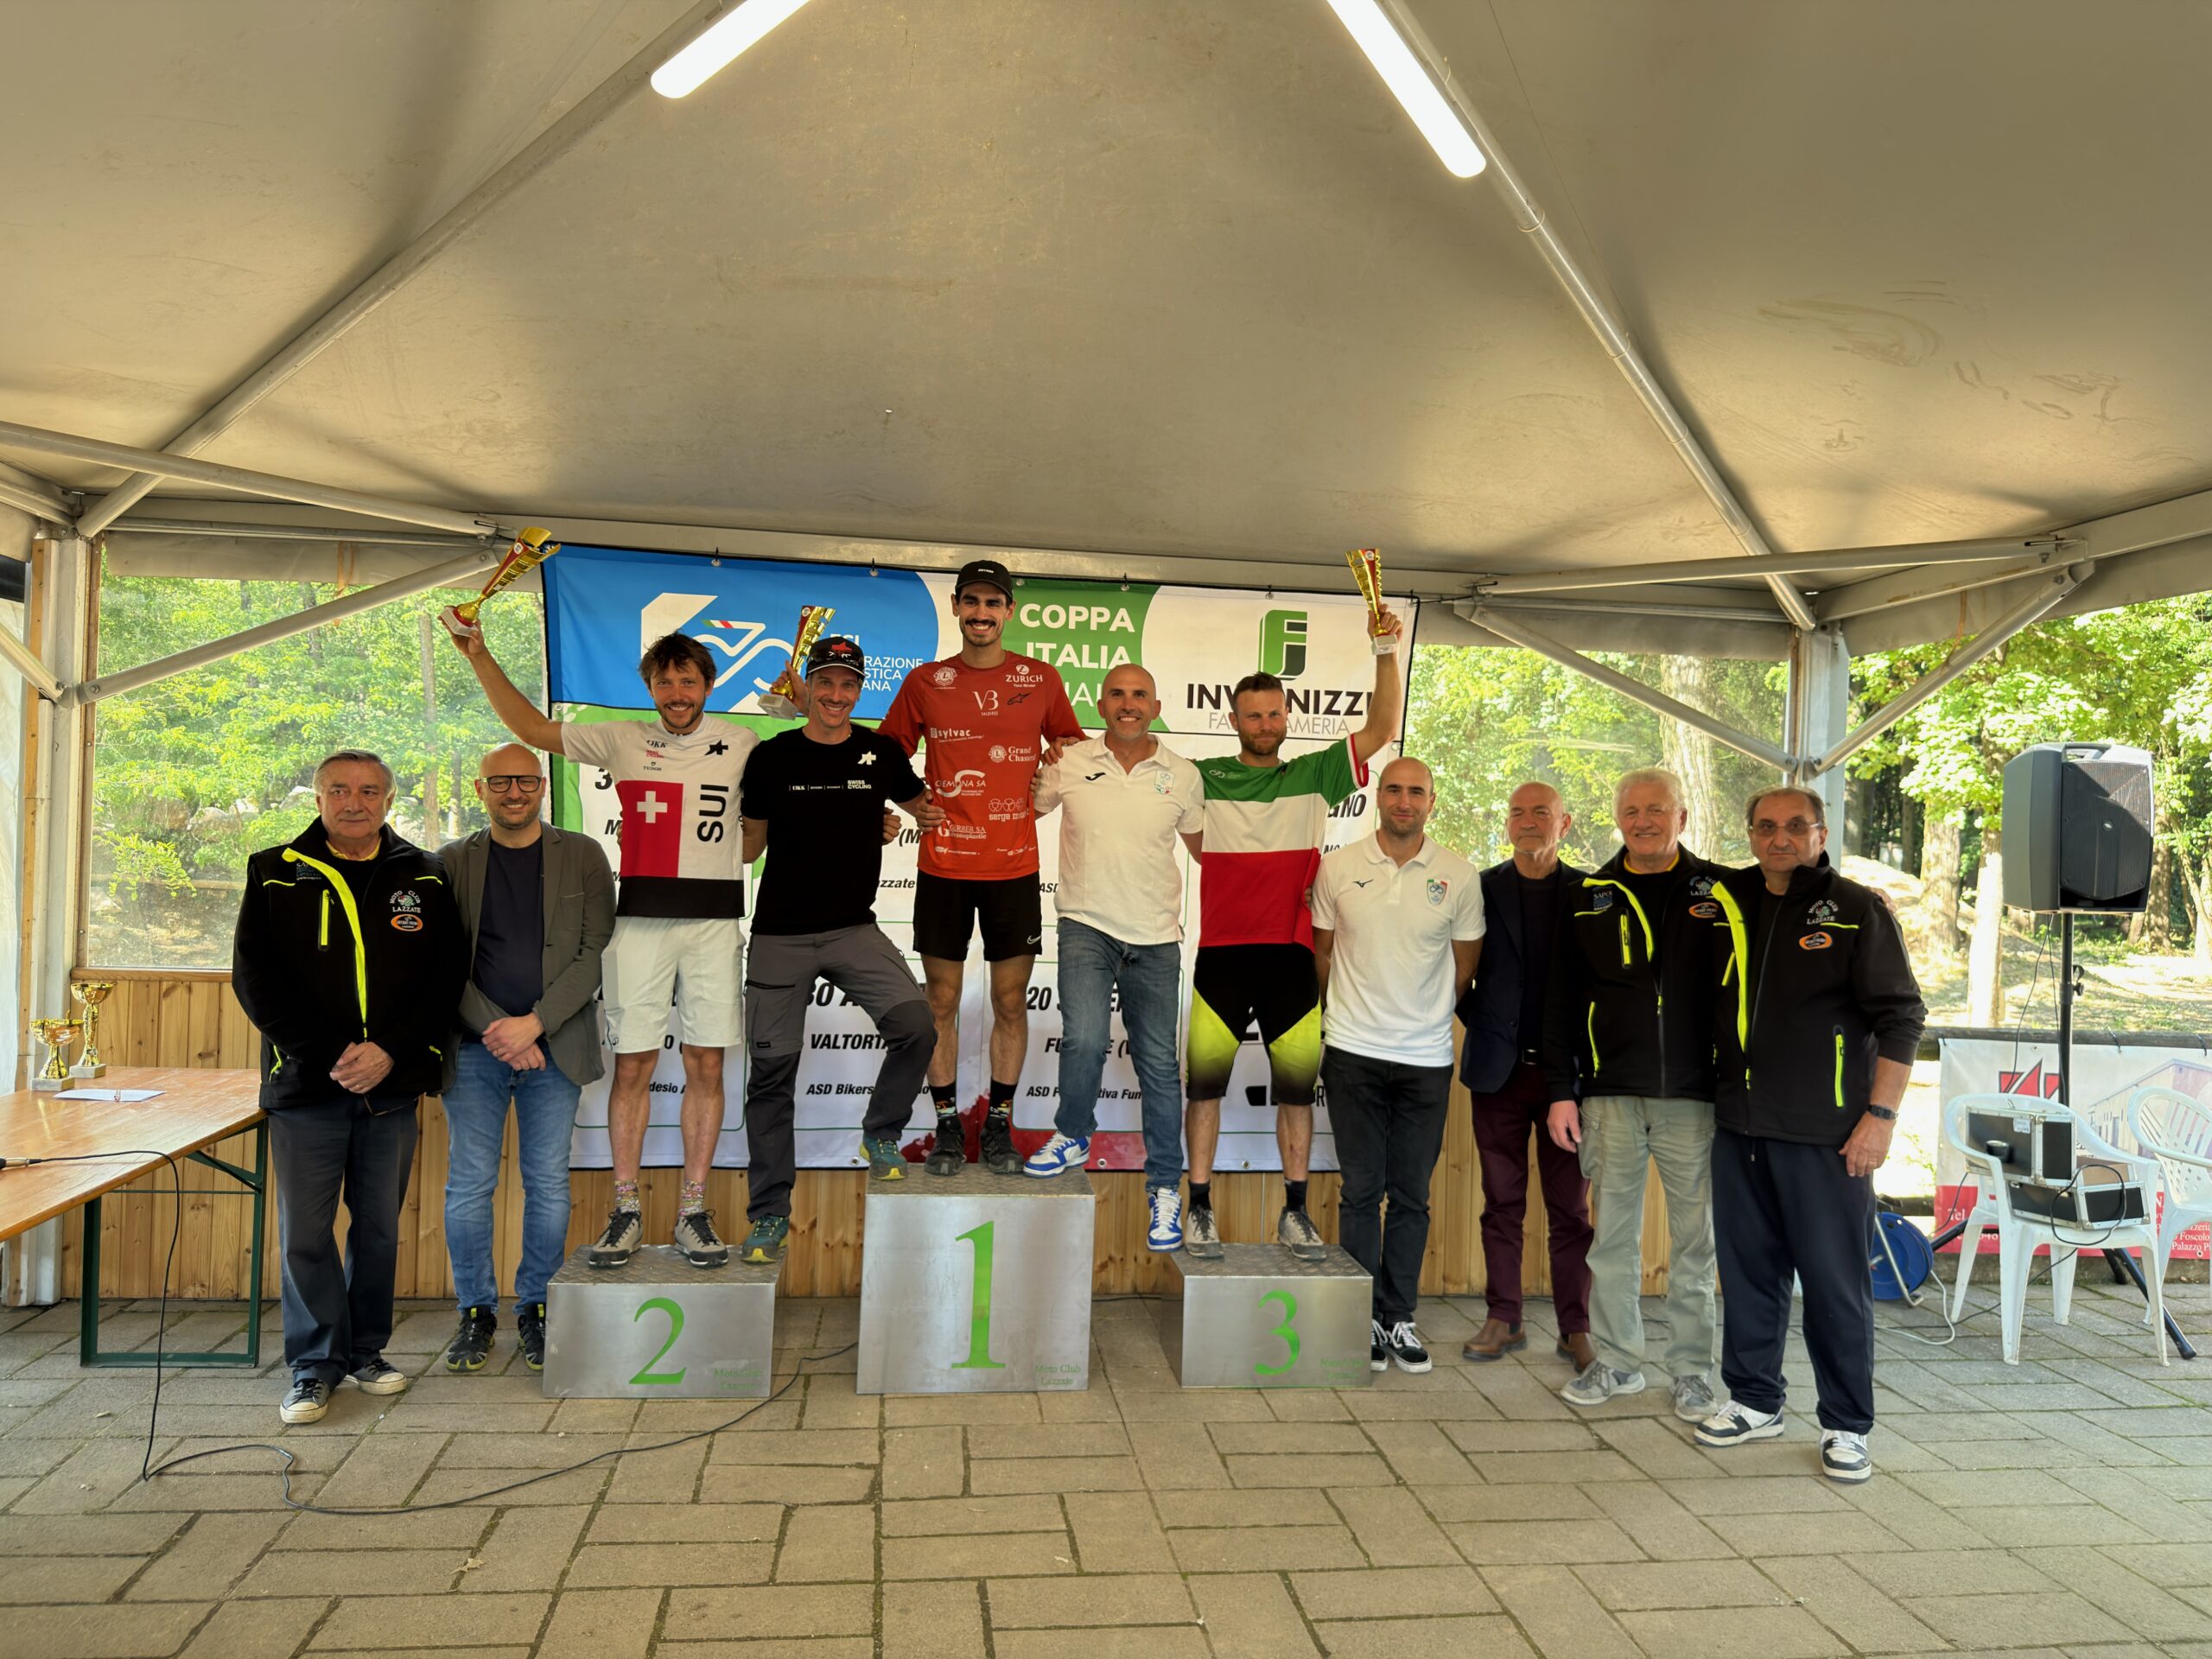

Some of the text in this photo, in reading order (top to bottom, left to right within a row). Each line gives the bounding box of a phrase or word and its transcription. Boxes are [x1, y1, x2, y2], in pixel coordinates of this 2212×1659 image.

[1020, 603, 1135, 632] COPPA
[1027, 642, 1132, 670] ITALIA
[865, 656, 924, 669] RAZIONE
[865, 668, 902, 680] STICA
[861, 680, 892, 691] ANA
[938, 728, 970, 739] sylvac
[696, 784, 729, 843] SUI
[988, 813, 1010, 822] serge
[880, 878, 915, 889] zzate
[389, 890, 421, 904] MOTO CLUB
[1808, 899, 1839, 913] MOTO CLUB
[1806, 915, 1835, 925] LAZZATE
[1027, 987, 1052, 1011] 20
[810, 1033, 887, 1050] VALTORT
[650, 1082, 677, 1094] desio
[806, 1084, 874, 1095] ASD Bikers
[1027, 1086, 1049, 1097] ASD
[2179, 1232, 2210, 1241] Foscolo
[2171, 1242, 2202, 1251] Palazzo
[951, 1220, 1006, 1369] 1
[1254, 1289, 1300, 1376] 3
[628, 1297, 687, 1384] 2
[1059, 1363, 1081, 1373] Club
